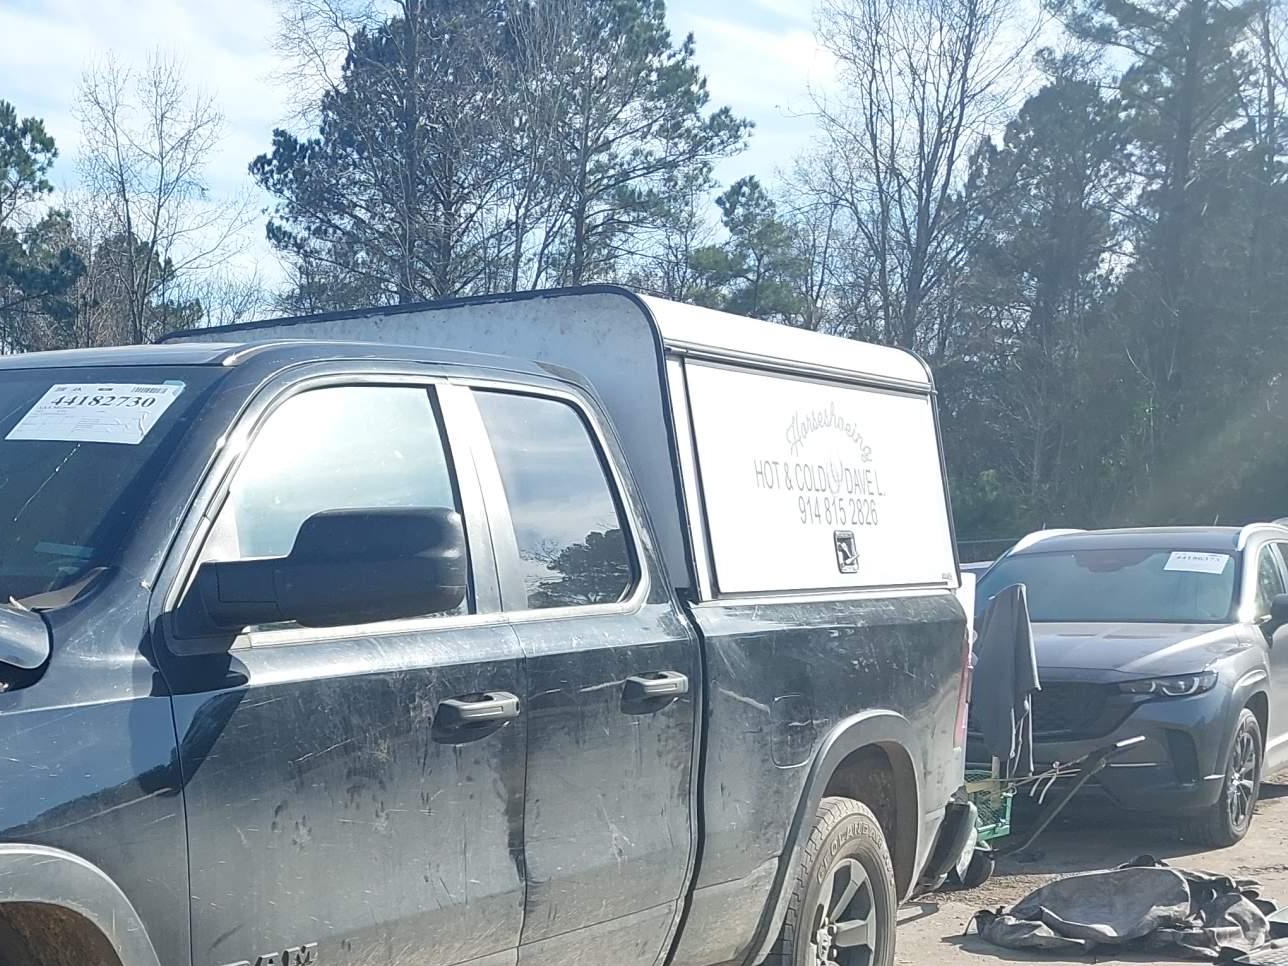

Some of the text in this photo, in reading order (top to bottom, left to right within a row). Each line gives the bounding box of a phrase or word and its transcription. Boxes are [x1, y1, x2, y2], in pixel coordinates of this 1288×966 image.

[51, 395, 157, 408] 44182730
[786, 401, 873, 463] Horseshoeing
[754, 459, 780, 489] HOT
[783, 462, 793, 490] &
[795, 463, 827, 492] COLD
[845, 468, 874, 496] DAVE
[798, 495, 879, 526] 914 815 2826
